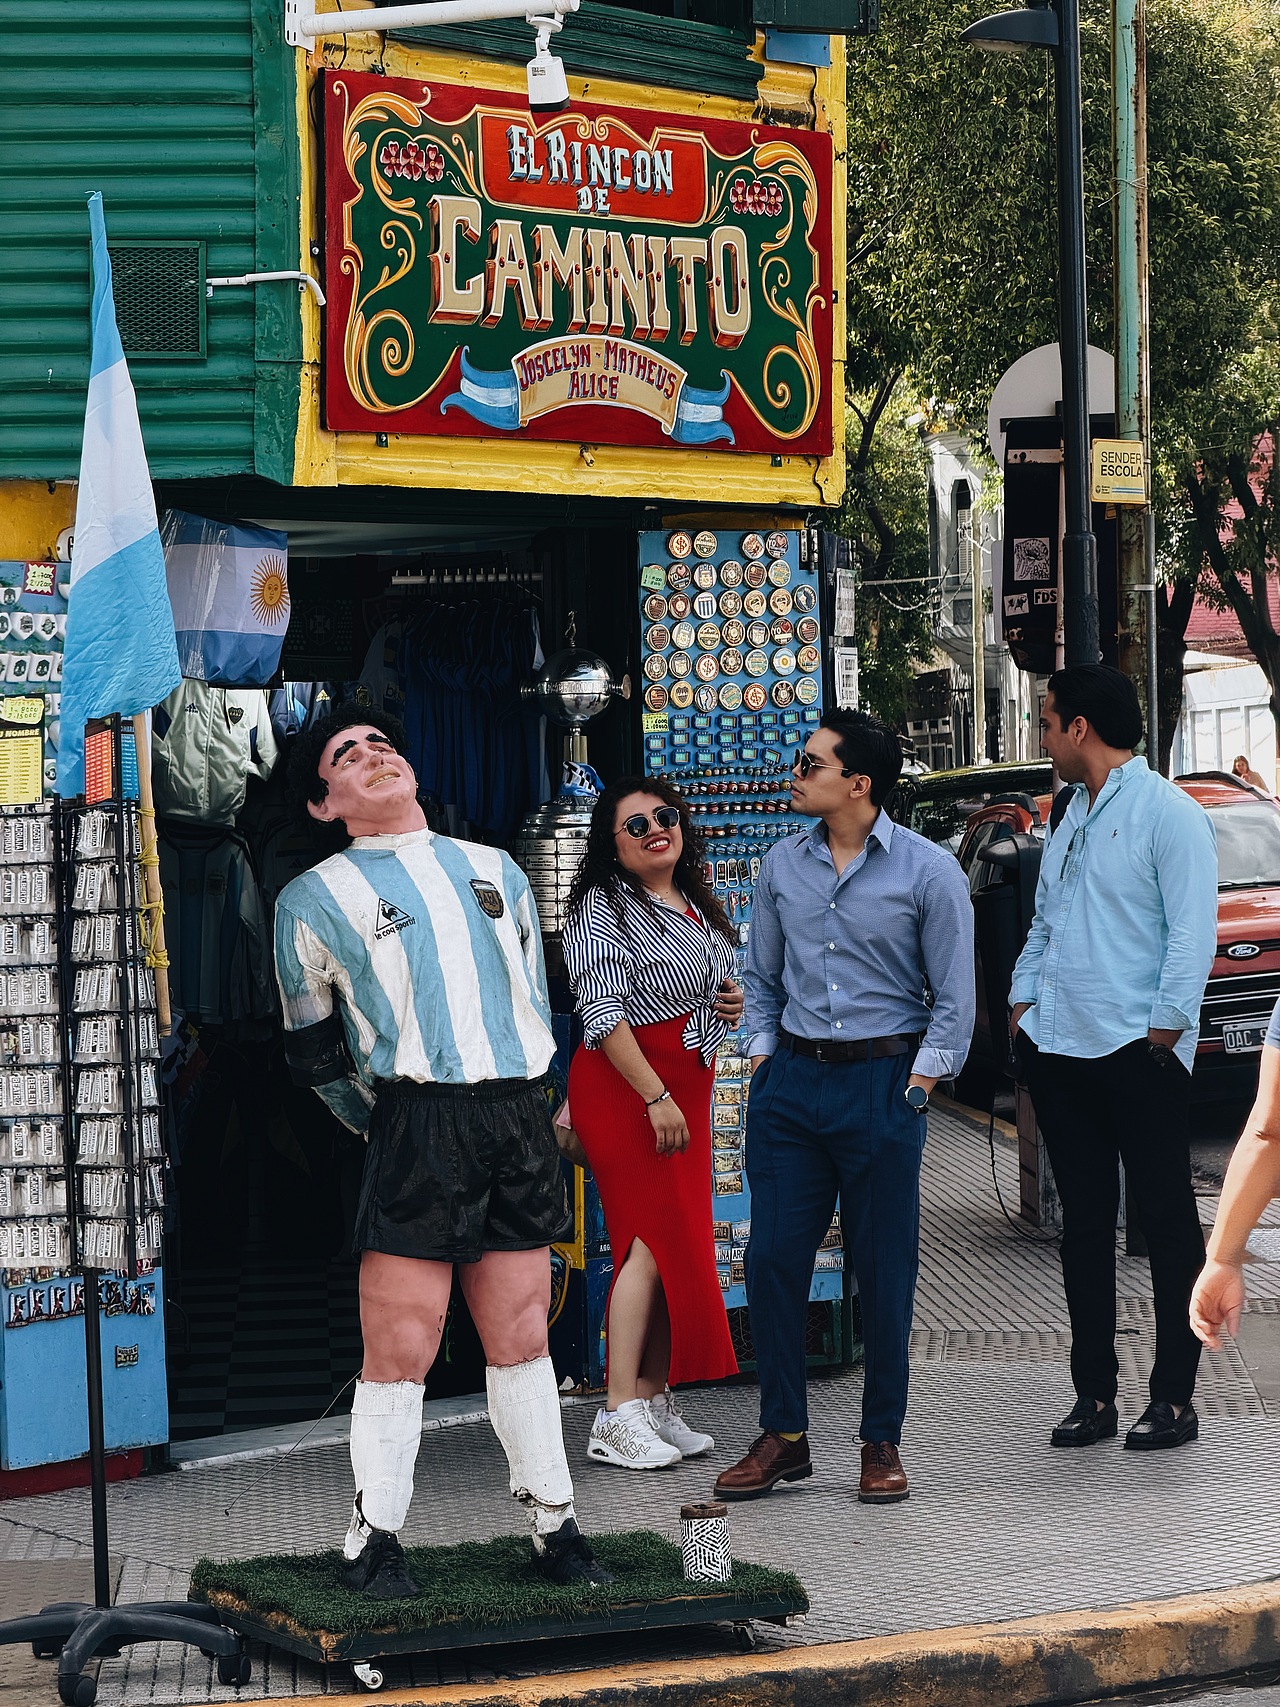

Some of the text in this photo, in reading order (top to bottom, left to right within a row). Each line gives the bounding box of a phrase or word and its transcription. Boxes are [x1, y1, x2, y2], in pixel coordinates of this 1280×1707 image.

[506, 125, 674, 196] EL RINCON
[576, 186, 611, 216] DE
[427, 194, 751, 350] CAMINITO
[516, 343, 591, 391] JOSCELYN
[604, 340, 677, 399] MATHEUS
[567, 371, 620, 399] ALICE
[1101, 451, 1142, 465] SENDER
[1101, 464, 1143, 478] ESCOLA
[1034, 590, 1057, 604] FDS
[5, 729, 40, 738] NOMBRE
[4, 827, 12, 853] ADRIAN
[15, 823, 23, 850] ADRIANA
[4, 879, 12, 897] ALAN
[5, 926, 13, 953] ALICIA
[374, 917, 416, 941] le coq sportif
[1234, 945, 1252, 955] Ford
[38, 976, 46, 1003] ANGELA
[22, 1029, 30, 1053] ARIEL
[1226, 1030, 1252, 1049] OAC
[13, 1077, 21, 1105] BEATRIZ
[28, 1077, 36, 1104] BELEN
[15, 1131, 23, 1152] BRISA
[44, 1126, 52, 1155] CAMILA
[31, 1230, 39, 1254] CLARA
[47, 1228, 56, 1256] CLARISA
[815, 1257, 844, 1268] RGENTINA
